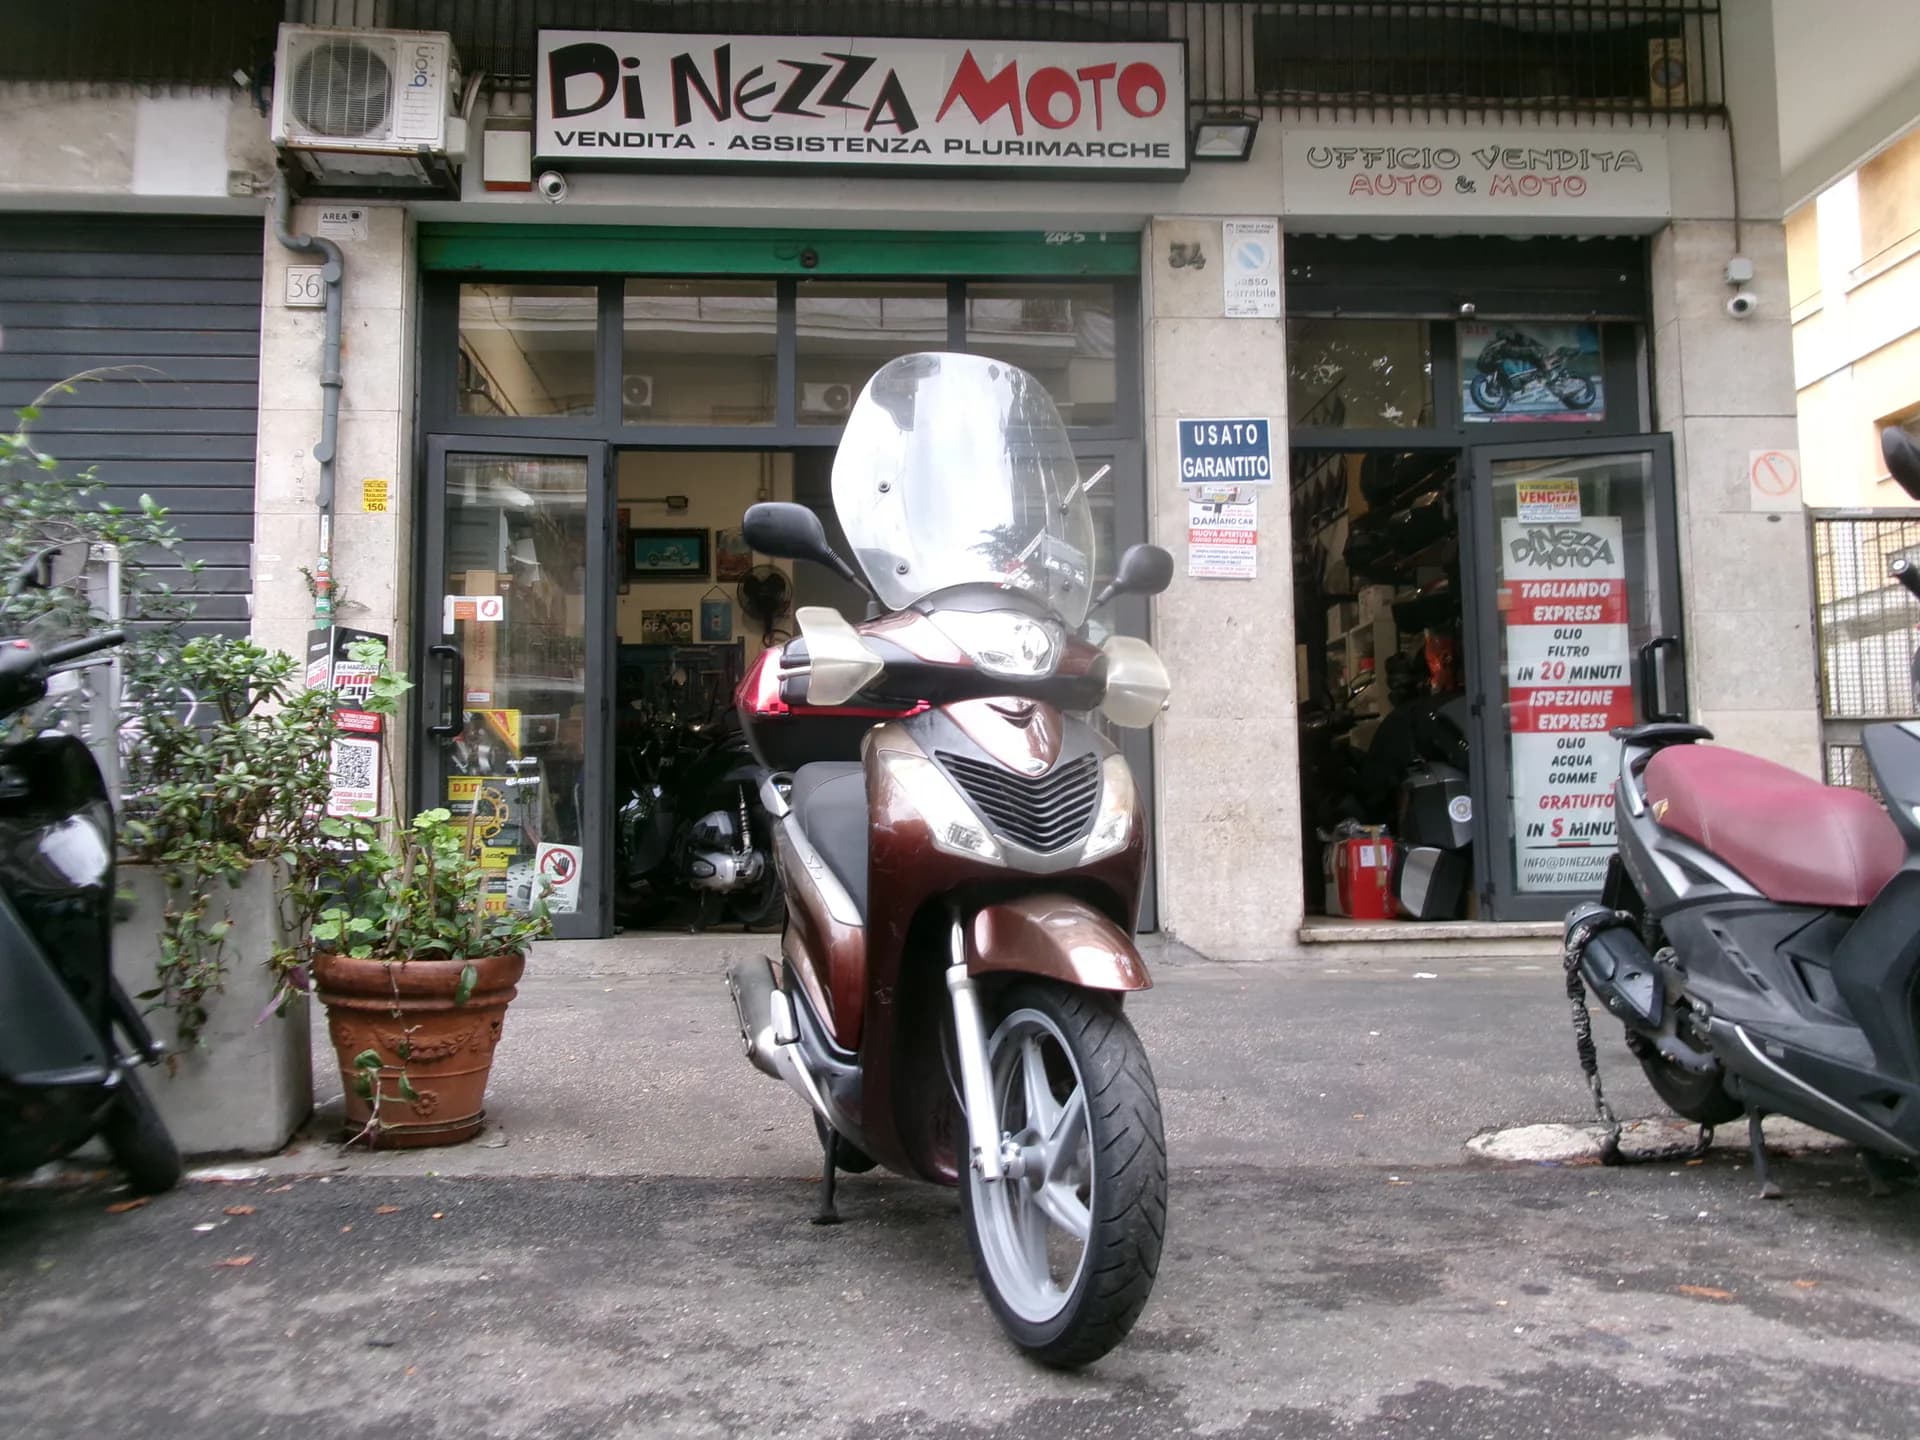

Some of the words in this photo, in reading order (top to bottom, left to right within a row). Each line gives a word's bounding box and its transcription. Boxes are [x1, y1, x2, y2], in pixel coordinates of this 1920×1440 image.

[935, 48, 1167, 136] MOTO
[554, 131, 696, 150] VENDITA
[727, 134, 931, 154] ASSISTENZA
[944, 138, 1170, 159] PLURIMARCHE
[1306, 147, 1461, 170] UFFICIO
[1471, 145, 1643, 172] VENDITA
[1349, 174, 1443, 197] AUTO
[1455, 175, 1477, 193] &
[1489, 174, 1587, 197] MOTO
[322, 212, 348, 221] AREA
[289, 273, 321, 299] 36
[1194, 424, 1258, 446] USATO
[1183, 456, 1269, 478] GARANTITO
[1519, 490, 1578, 504] VENDITA
[1528, 546, 1594, 570] MOTO
[1521, 582, 1610, 598] TAGLIANDO
[1533, 605, 1602, 621] EXPRESS
[1554, 628, 1583, 640] OLIO
[1547, 646, 1590, 657] FILTRO
[1517, 667, 1534, 681] IN
[1540, 661, 1565, 680] 20
[1569, 665, 1622, 680] MINUTI
[1529, 690, 1613, 706] ISPEZIONE
[1538, 713, 1607, 730] EXPRESS
[1556, 738, 1586, 749] OLIO
[1552, 755, 1593, 767] ACQUA
[1548, 772, 1598, 784] GOMME
[1539, 794, 1616, 809] GRATUITO
[1526, 823, 1544, 837] IN
[1551, 818, 1563, 838] 5
